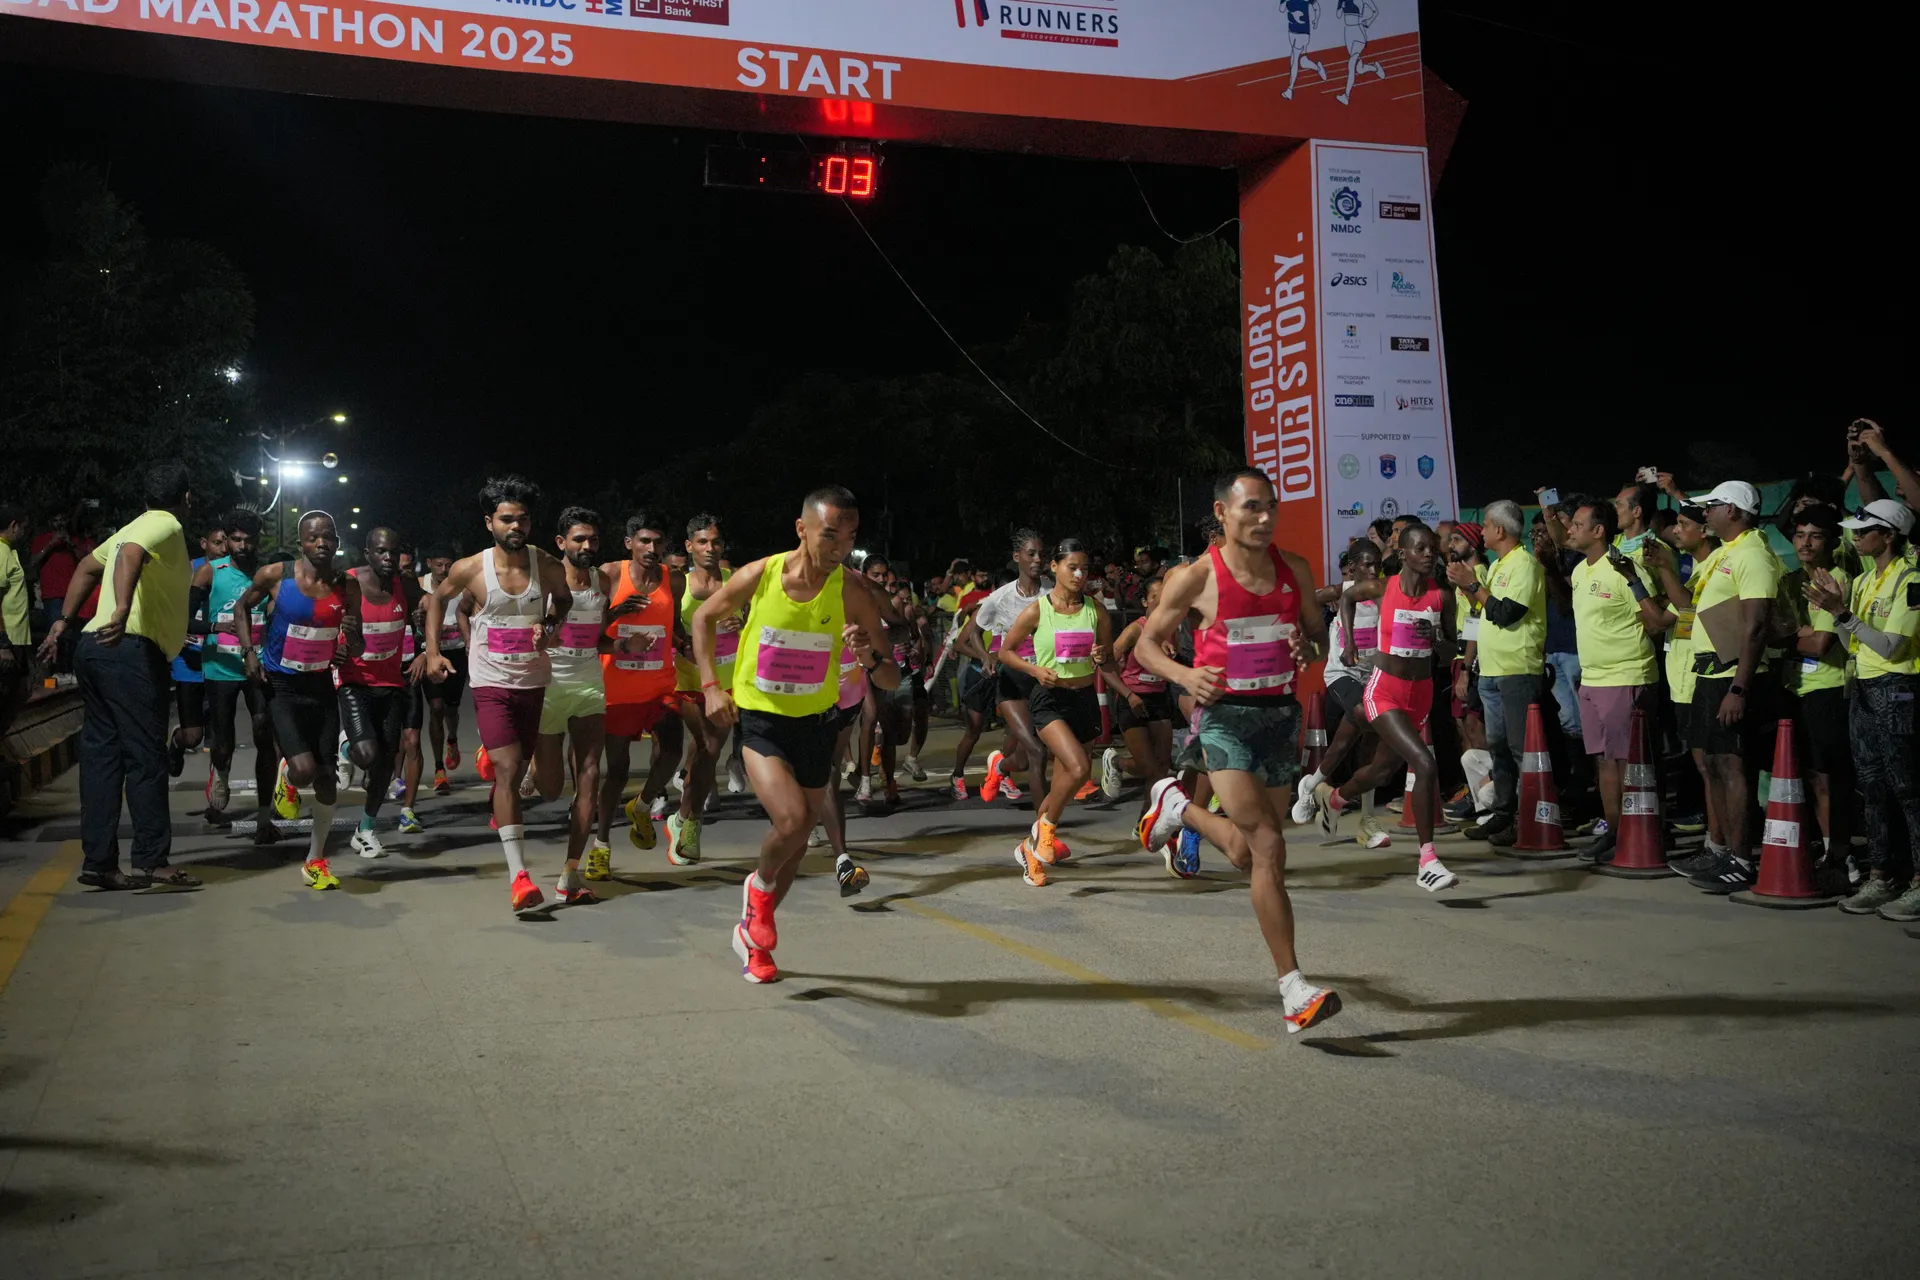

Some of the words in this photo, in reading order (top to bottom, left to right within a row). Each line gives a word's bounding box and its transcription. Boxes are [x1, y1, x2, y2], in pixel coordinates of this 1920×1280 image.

[665, 6, 692, 17] Bank
[1000, 5, 1119, 34] RUNNERS
[140, 0, 444, 54] MARATHON
[461, 23, 574, 67] 2025
[1021, 33, 1058, 42] discover
[1060, 36, 1097, 46] yourself
[737, 47, 901, 100] START
[1331, 223, 1362, 234] NMDC
[1342, 275, 1368, 287] asics
[1391, 281, 1416, 292] Apollo
[1410, 396, 1434, 406] HITEX
[1360, 433, 1401, 441] SUPPORTED
[1281, 400, 1313, 493] OUR
[1337, 508, 1358, 516] hmda
